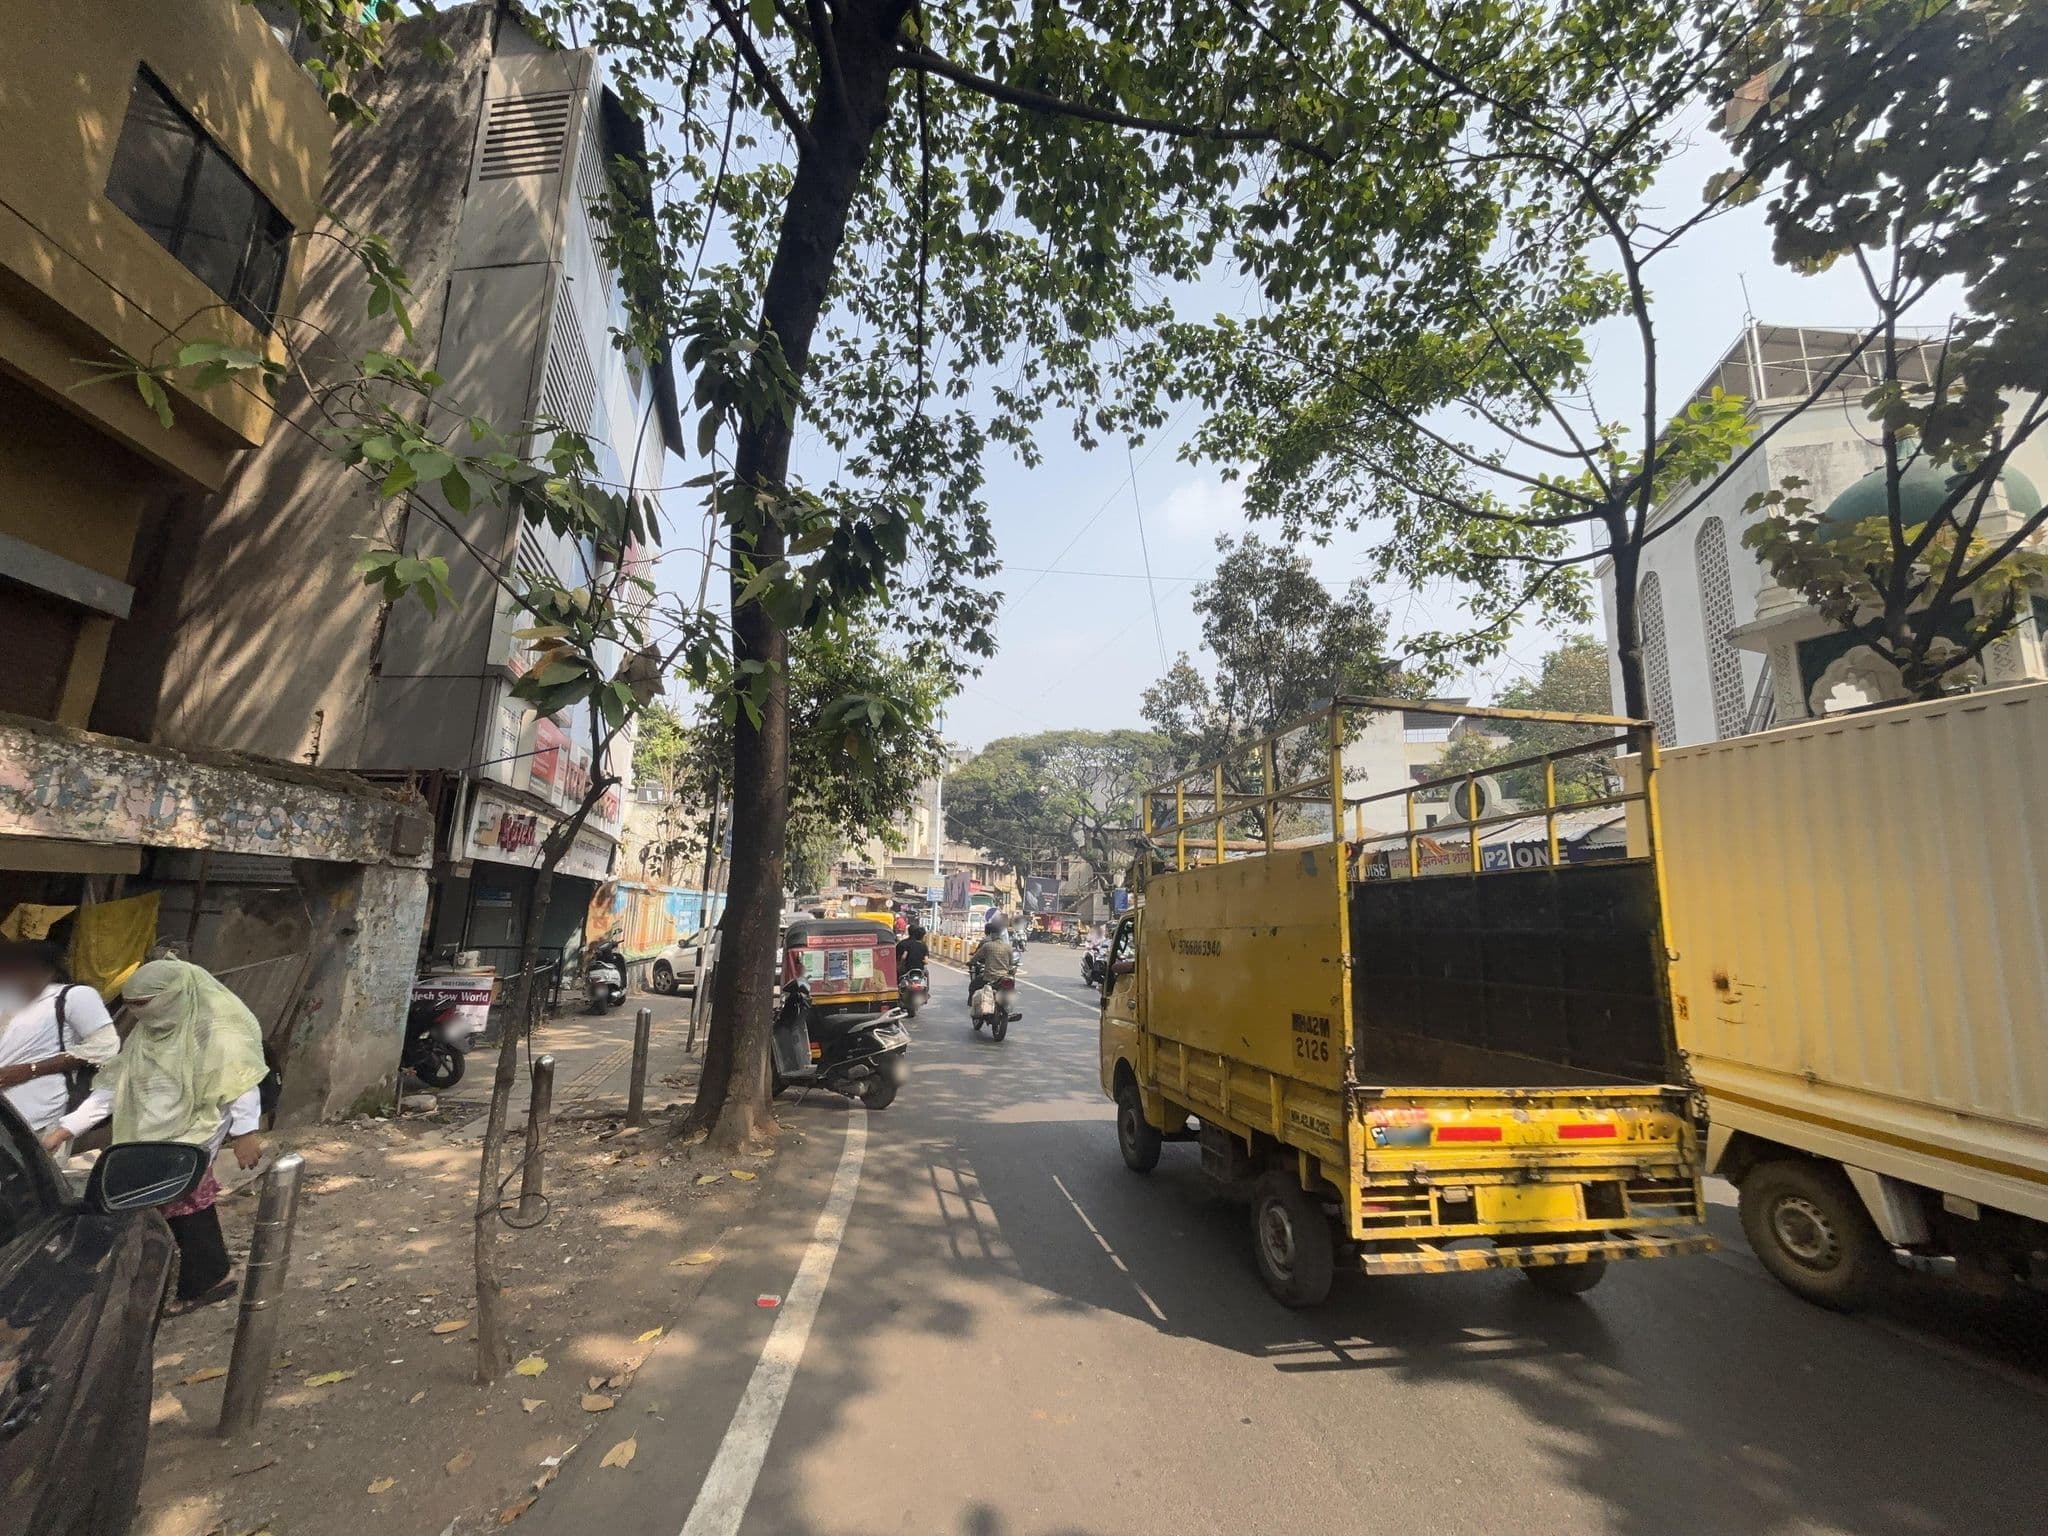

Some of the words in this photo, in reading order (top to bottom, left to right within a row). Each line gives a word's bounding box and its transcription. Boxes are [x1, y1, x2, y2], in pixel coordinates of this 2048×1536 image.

[1484, 849, 1508, 868] P2
[461, 991, 489, 1002] World
[1296, 1037, 1329, 1062] 2126
